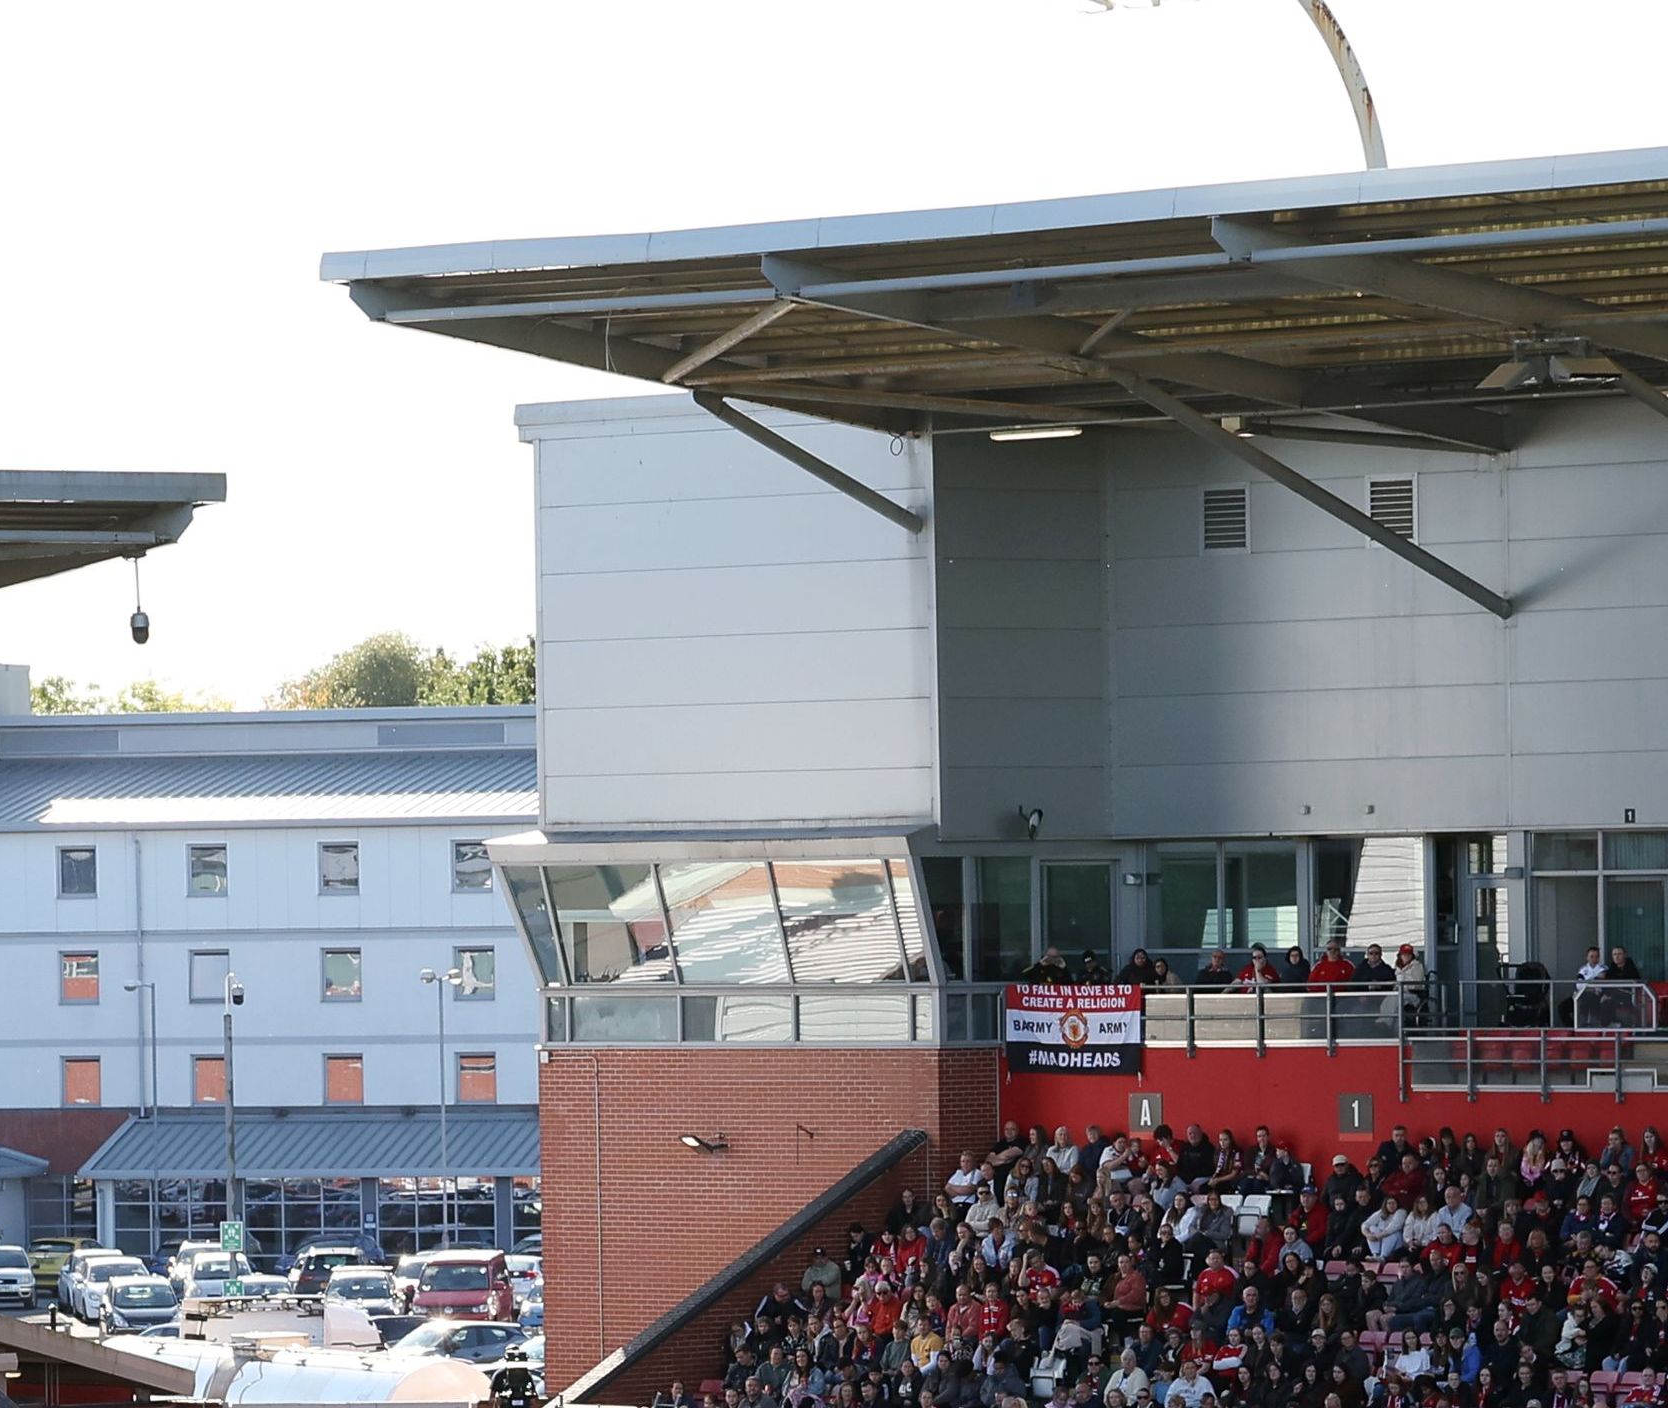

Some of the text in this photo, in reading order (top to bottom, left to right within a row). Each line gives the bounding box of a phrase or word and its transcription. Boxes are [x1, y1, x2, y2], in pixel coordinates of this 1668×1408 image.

[1627, 810, 1633, 821] 1
[1016, 985, 1132, 997] TO FALL IN LOVE IS TO
[1022, 997, 1126, 1009] CREATE A RELIGION
[1013, 1019, 1053, 1034] BARMY
[1140, 1099, 1152, 1127] A
[1350, 1099, 1359, 1128] 1
